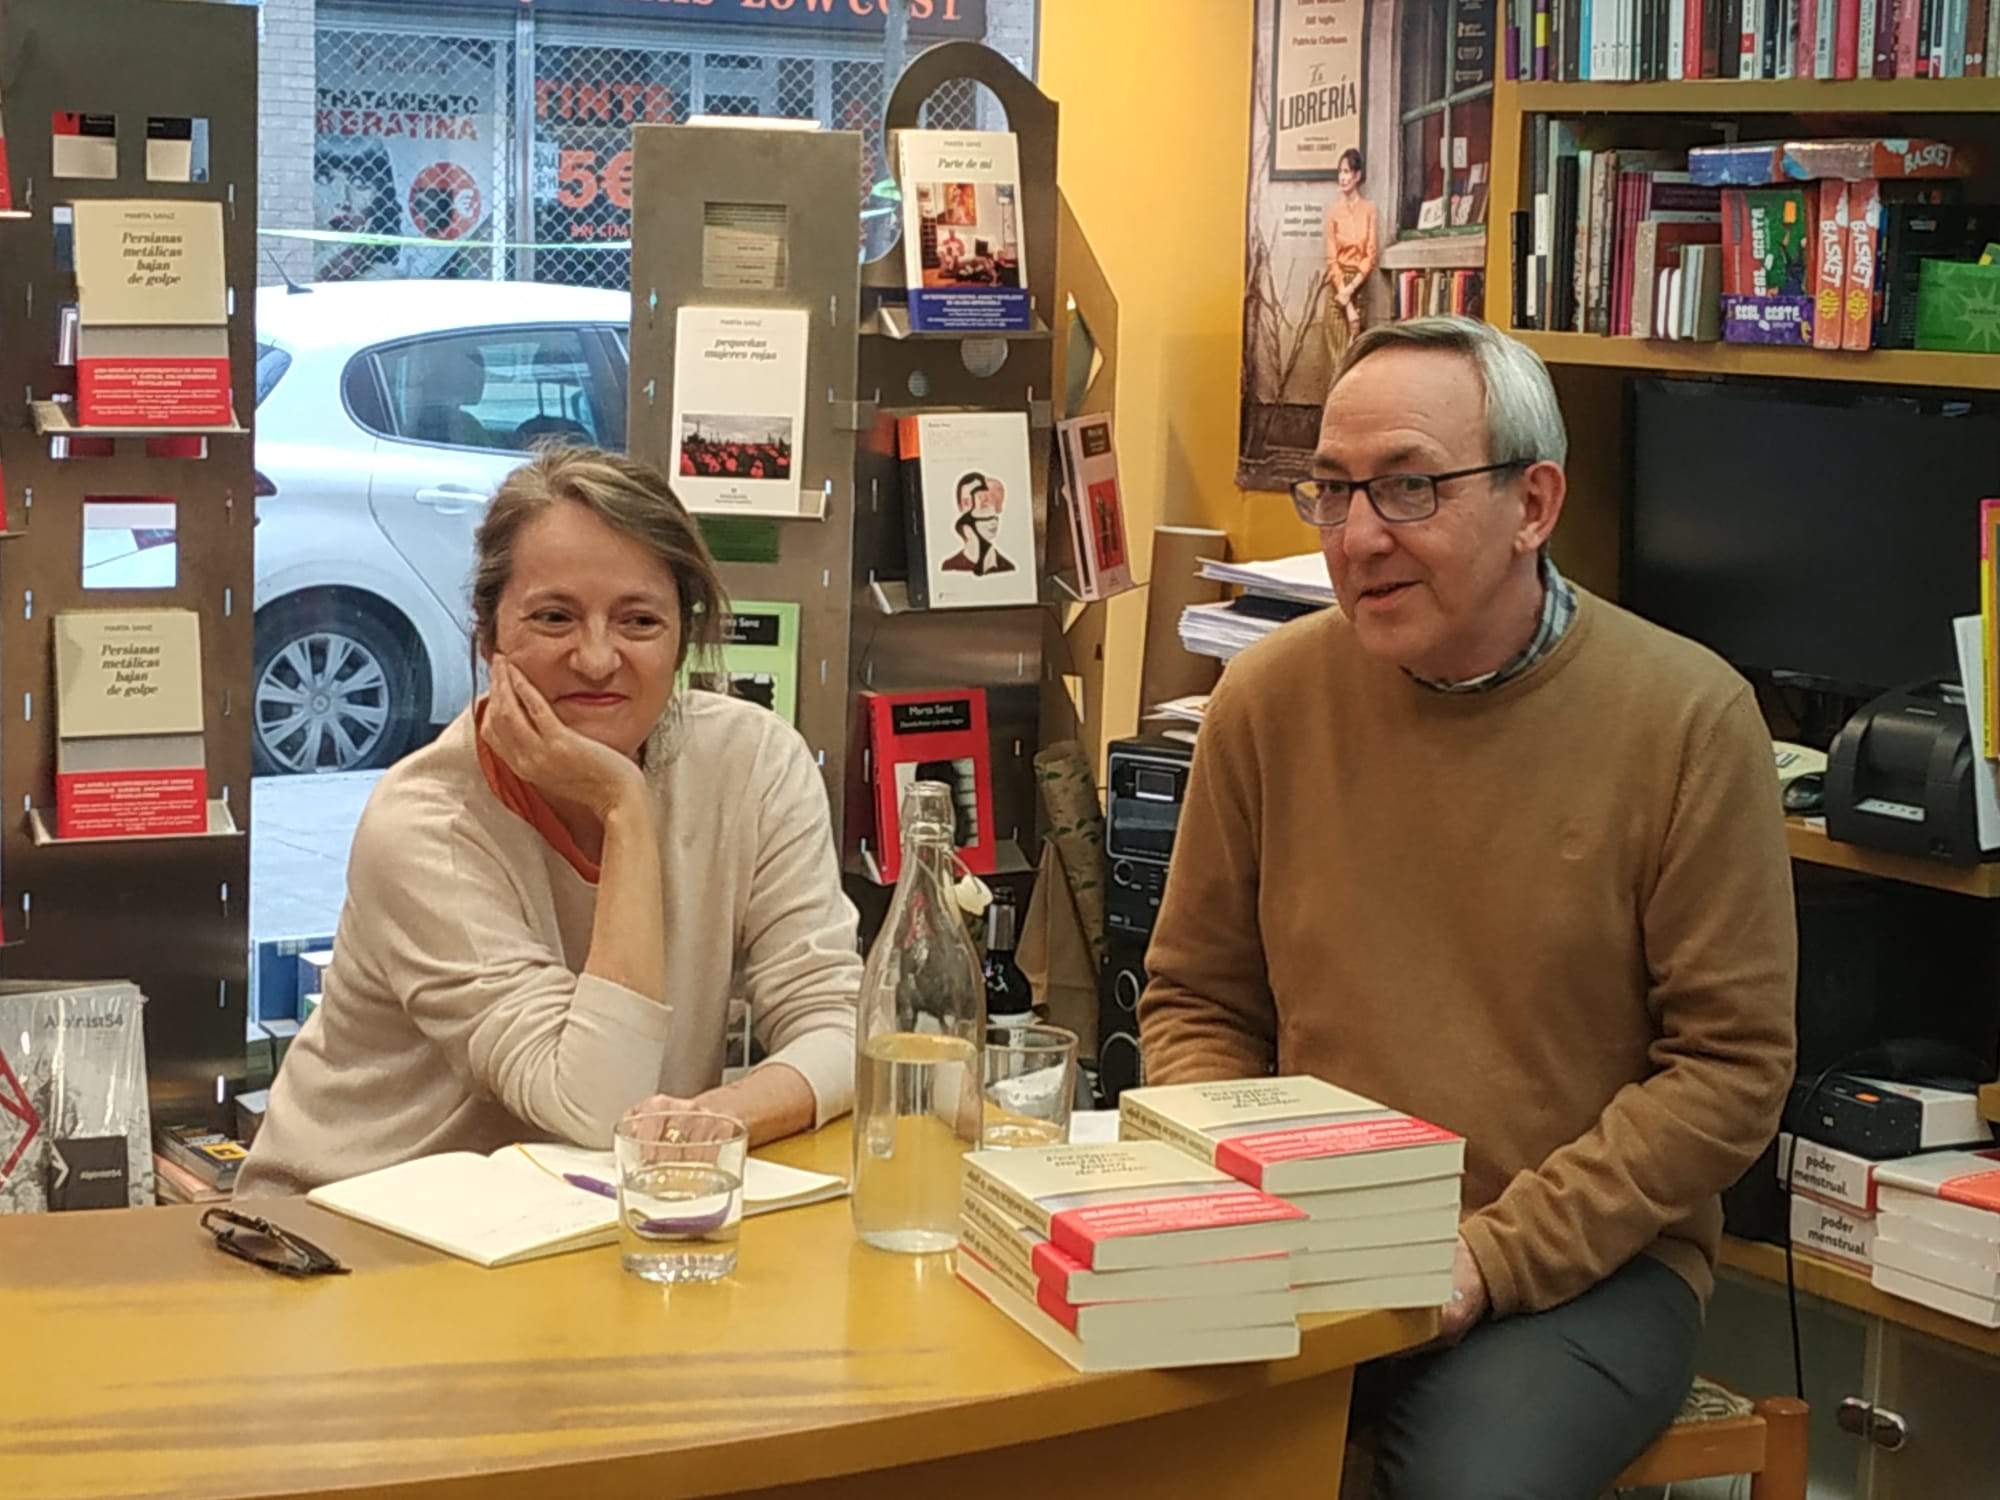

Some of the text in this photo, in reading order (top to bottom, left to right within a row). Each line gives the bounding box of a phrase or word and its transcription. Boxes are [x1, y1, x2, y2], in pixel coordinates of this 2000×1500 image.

[316, 88, 479, 115] TRATAMIENTO
[1279, 73, 1357, 131] LIBRERÍA
[315, 110, 479, 141] KERATINA
[937, 157, 963, 169] Parte
[965, 157, 977, 168] de
[1903, 144, 1954, 175] BASKET
[122, 231, 183, 244] Persianas
[122, 244, 183, 258] metálicas
[1820, 219, 1844, 288] BASKET
[1850, 219, 1874, 288] BASKET
[136, 259, 171, 273] bajan
[127, 273, 181, 288] de golpe
[714, 338, 767, 350] pequeñas
[704, 349, 778, 362] mujeres rojas
[101, 642, 161, 657] Persianas
[102, 656, 161, 670] metálicas
[115, 670, 149, 684] bajan
[106, 683, 159, 698] de golpe
[1805, 1154, 1836, 1173] poder
[1794, 1168, 1849, 1196] menstrual.
[1820, 1215, 1854, 1233] poder
[1807, 1228, 1868, 1257] menstrual.
